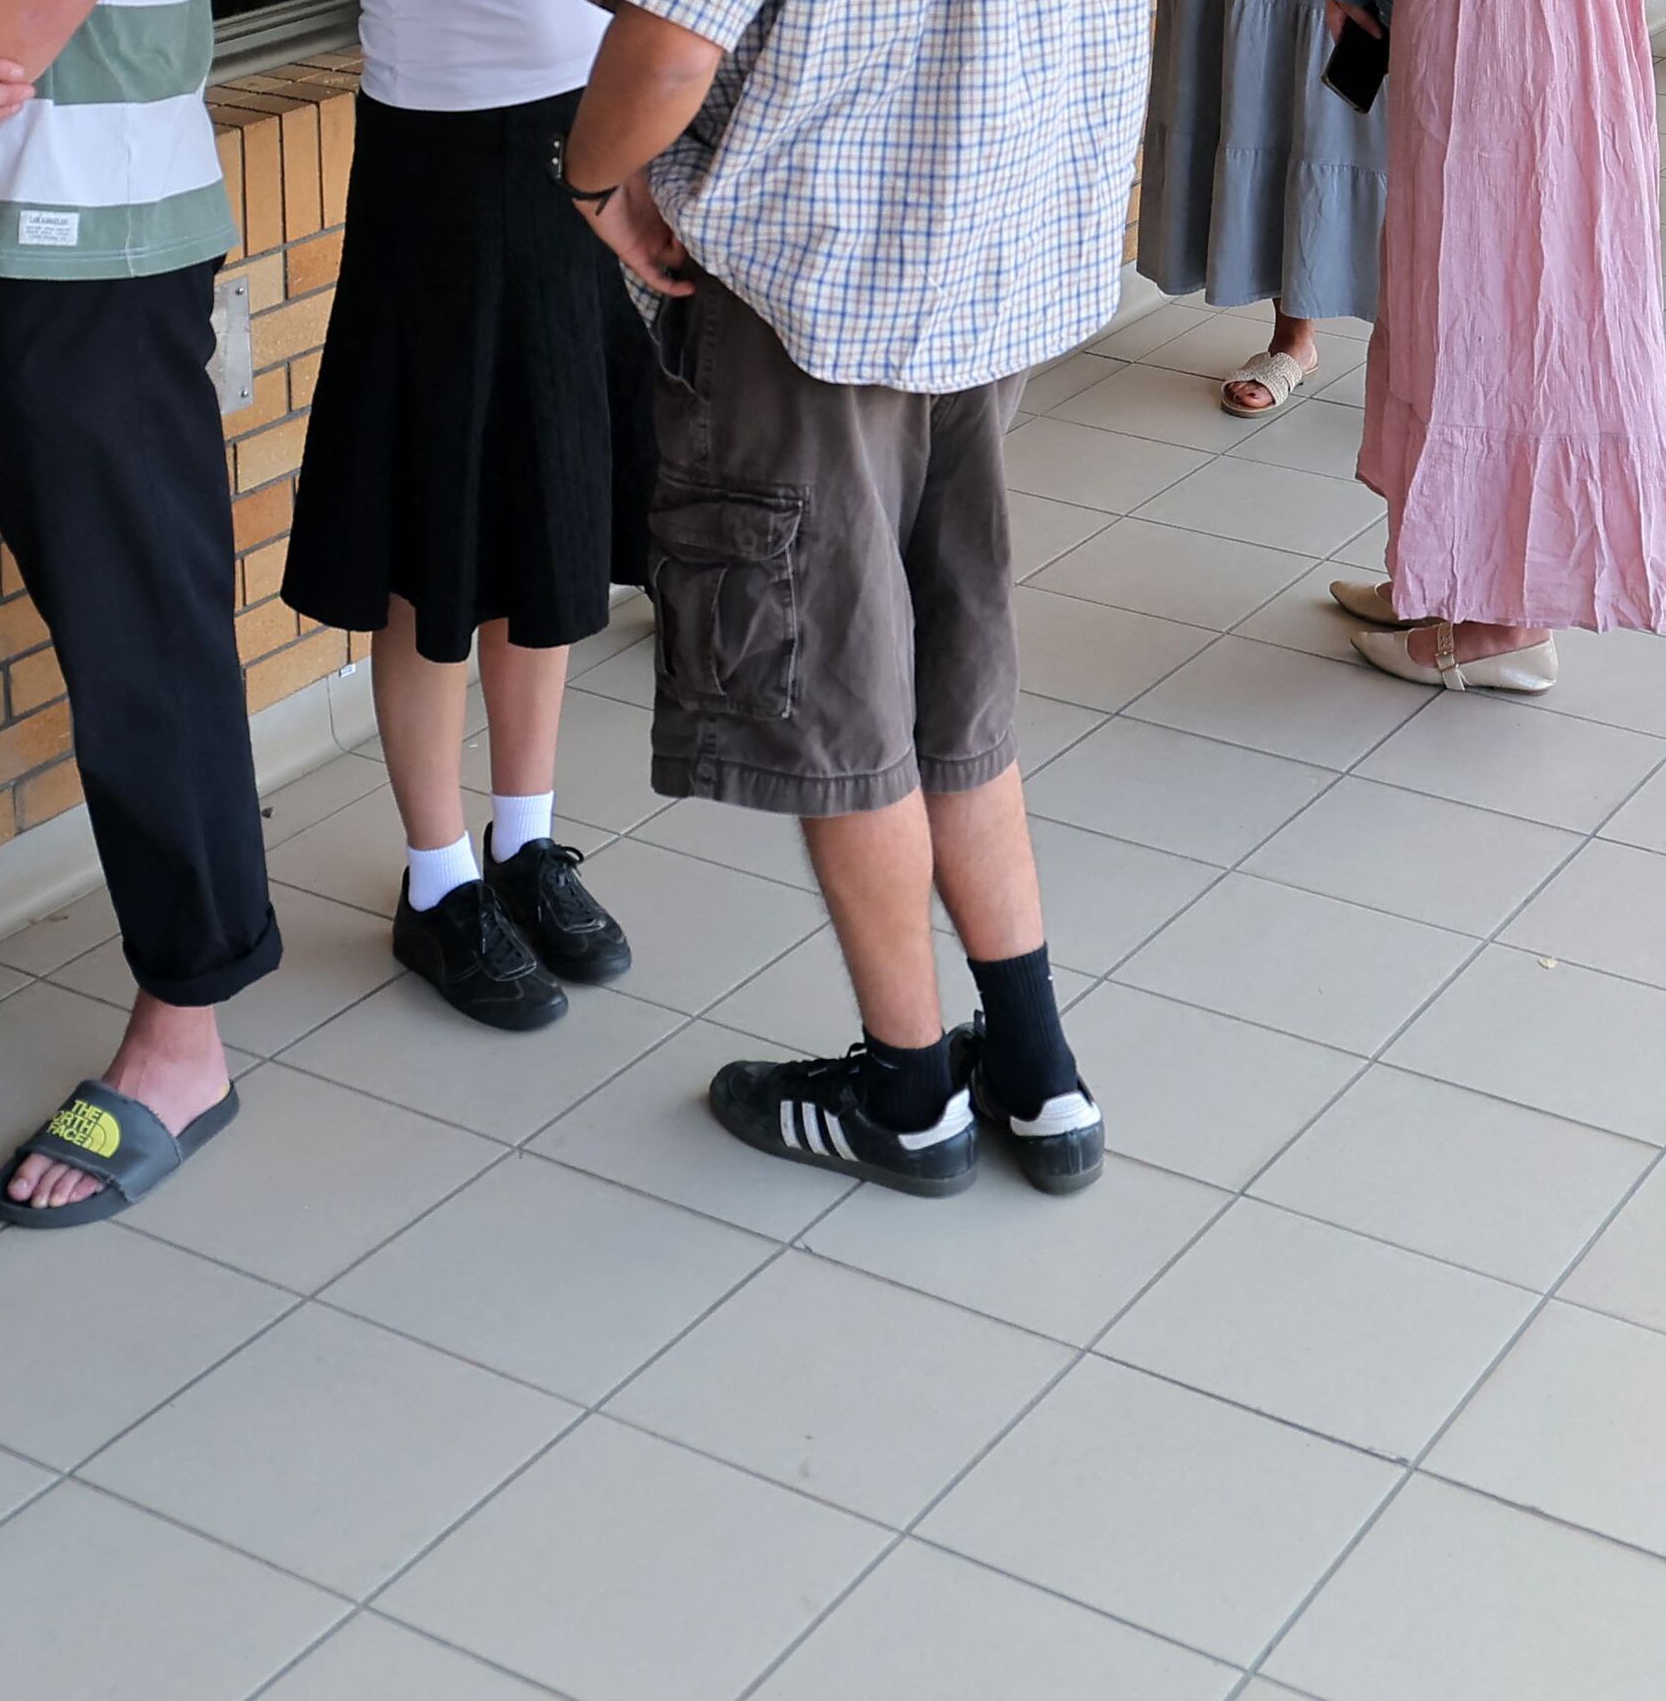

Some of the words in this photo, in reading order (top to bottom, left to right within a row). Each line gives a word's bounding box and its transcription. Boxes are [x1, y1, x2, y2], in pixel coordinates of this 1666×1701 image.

[52, 1110, 95, 1136] ORTH
[72, 1100, 103, 1123] THE
[46, 1121, 88, 1146] FACE
